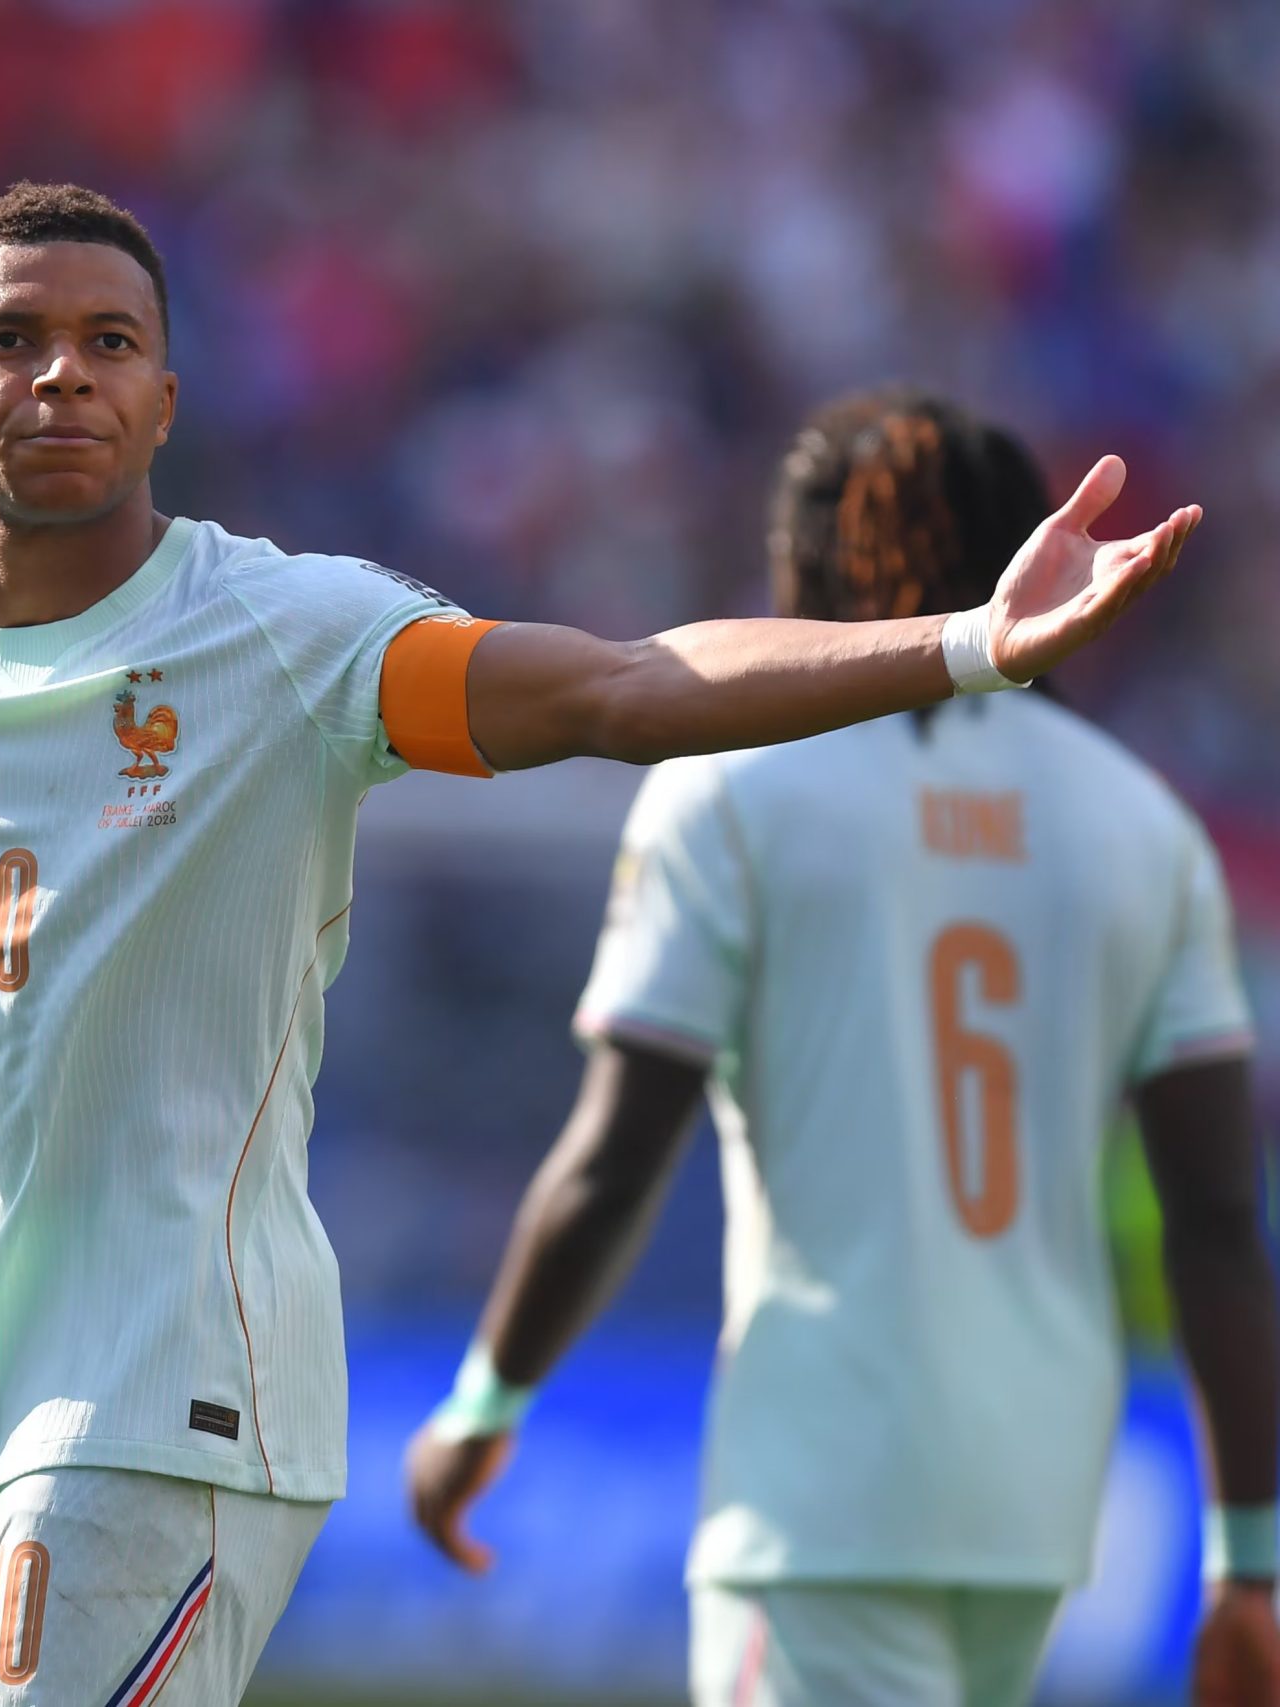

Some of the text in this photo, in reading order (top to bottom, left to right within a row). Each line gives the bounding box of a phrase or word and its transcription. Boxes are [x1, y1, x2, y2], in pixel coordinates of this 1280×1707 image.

[143, 800, 177, 814] MAROC
[147, 813, 177, 827] 2026
[927, 922, 1020, 1241] 6
